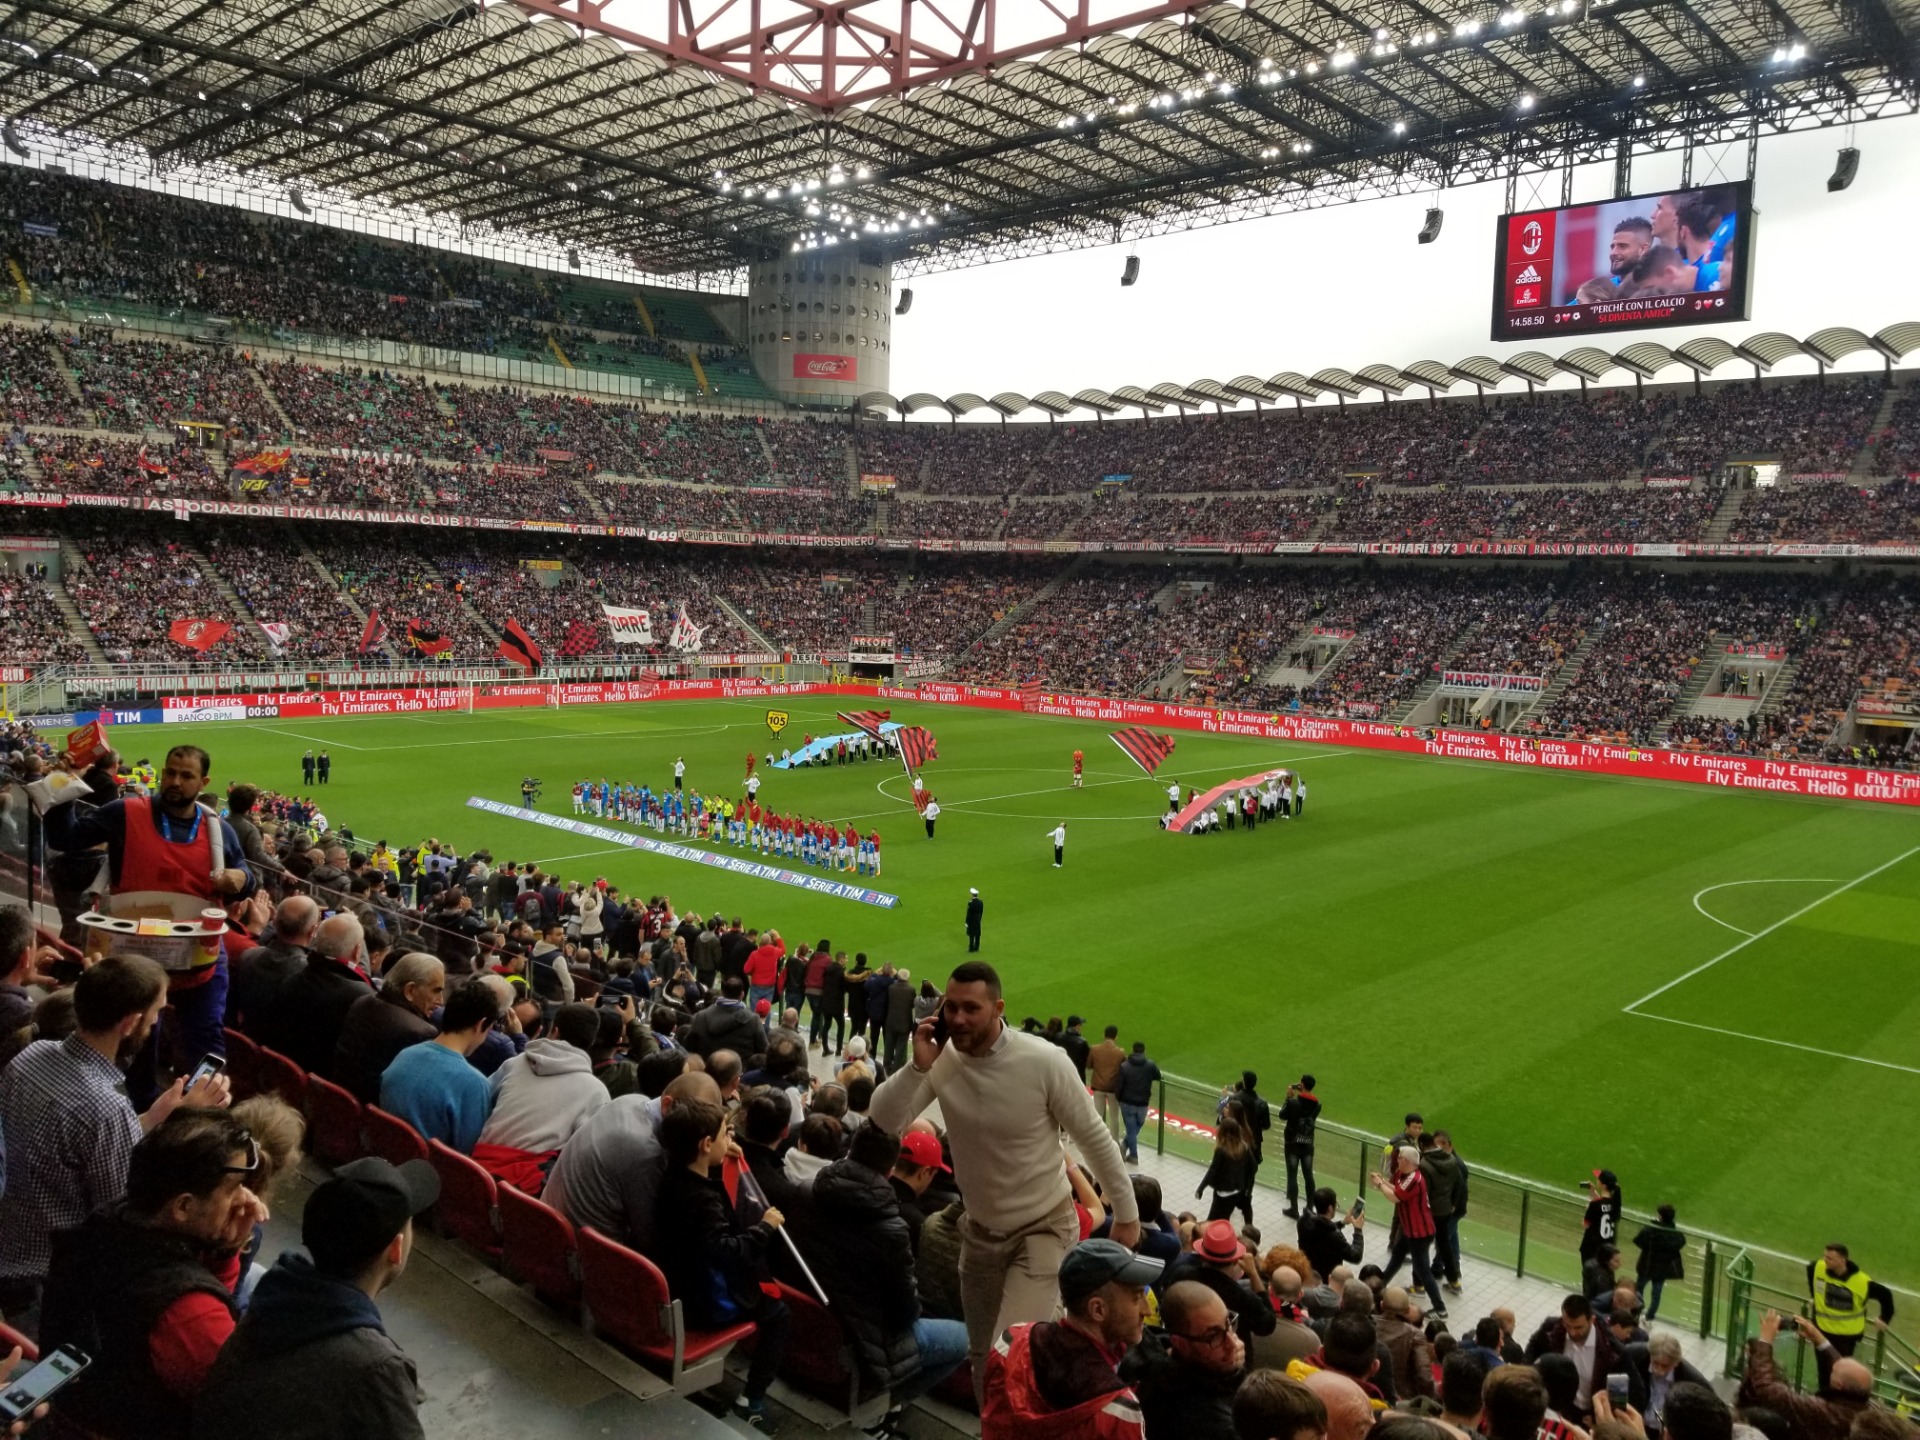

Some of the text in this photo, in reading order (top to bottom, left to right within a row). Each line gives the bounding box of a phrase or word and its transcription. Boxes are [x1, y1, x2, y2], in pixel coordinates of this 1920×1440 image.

[1516, 275, 1541, 284] adidas
[1625, 301, 1643, 311] CON
[1645, 300, 1653, 309] IL
[1655, 297, 1685, 308] CALCIO
[1510, 315, 1545, 328] 14.58.50
[1599, 312, 1642, 322] SI DIVENTA
[1791, 474, 1822, 484] CORSO
[24, 492, 62, 504] BOLZANO
[74, 495, 119, 506] CUGGIONO
[149, 499, 460, 527] ASOCIAZIONE ITALIANA MILAN CLUB
[617, 526, 647, 538] PAINA
[649, 530, 678, 542] 049
[683, 530, 714, 541] GRUPPO
[758, 535, 874, 547] NAVIGLIO ROSSONERO
[1431, 543, 1458, 555] 1973
[1495, 544, 1526, 555] BARESI
[1534, 544, 1628, 556] BASSANO BRESCIANO
[853, 638, 893, 647] ARCORE
[905, 666, 946, 677] BRESCIANO
[908, 661, 941, 670] BASSANO
[3, 668, 25, 681] CLUB
[329, 670, 500, 685] MILAN ACADEMY SCUOLA CALCIO
[540, 666, 632, 678] FAMILY DAY
[141, 675, 184, 691] ITALIANA
[187, 675, 215, 689] MILAN
[219, 674, 241, 689] CLUB
[279, 674, 305, 687] MILAN
[613, 683, 625, 691] Fly
[669, 681, 681, 689] Fly
[683, 680, 713, 688] Emirates
[722, 679, 734, 687] Fly
[932, 683, 957, 693] Emirates
[1444, 672, 1541, 692] MARCO NICO
[504, 686, 541, 696] Emirates
[568, 684, 602, 693] Emirates
[724, 687, 735, 696] Fly
[878, 688, 889, 697] Fly
[920, 691, 937, 700] Hello
[975, 688, 1002, 698] Emirates
[258, 694, 275, 705] Fly
[340, 690, 403, 701] Fly Emirates
[416, 690, 431, 700] Fly
[605, 692, 626, 701] Hello
[1010, 691, 1020, 700] Fly
[169, 696, 242, 708] Fly Emirates
[323, 703, 339, 715] Fly
[396, 700, 423, 711] Hello
[1058, 696, 1069, 705] Fly
[1071, 697, 1100, 707] Emirates
[1109, 701, 1155, 713] Fly Emirates
[178, 712, 232, 722] BANCO BPM
[248, 705, 278, 717] 00:00
[1076, 707, 1096, 718] Hello
[1164, 706, 1212, 719] Fly Emirates
[1222, 711, 1235, 722] Fly
[37, 717, 60, 727] MEN
[115, 712, 141, 723] TIM
[769, 716, 786, 726] 105
[1284, 717, 1339, 730] Fly Emirates
[1203, 720, 1217, 732] Fly
[1266, 726, 1291, 738] Hello
[1351, 723, 1366, 735] Fly
[1442, 731, 1486, 745] Emirates
[1500, 737, 1516, 749] Fly
[1425, 741, 1443, 756] Fly
[1505, 749, 1536, 764] Hello
[1582, 745, 1599, 757] Fly
[1670, 753, 1747, 771] Fly Emirates
[1765, 762, 1848, 780] Fly Emirates
[1707, 769, 1729, 786] Fly
[1808, 779, 1847, 796] Hello
[1866, 771, 1888, 786] Fly
[581, 825, 593, 834] TIM
[621, 833, 635, 845] TIM
[643, 840, 656, 849] TIM
[688, 849, 706, 862] TIM
[712, 855, 727, 867] TIM
[752, 864, 763, 876] A
[762, 866, 781, 880] TIM
[789, 873, 806, 885] TIM
[832, 883, 843, 895] A
[843, 885, 865, 900] TIM
[875, 893, 895, 906] TIM
[1600, 1214, 1615, 1239] 6
